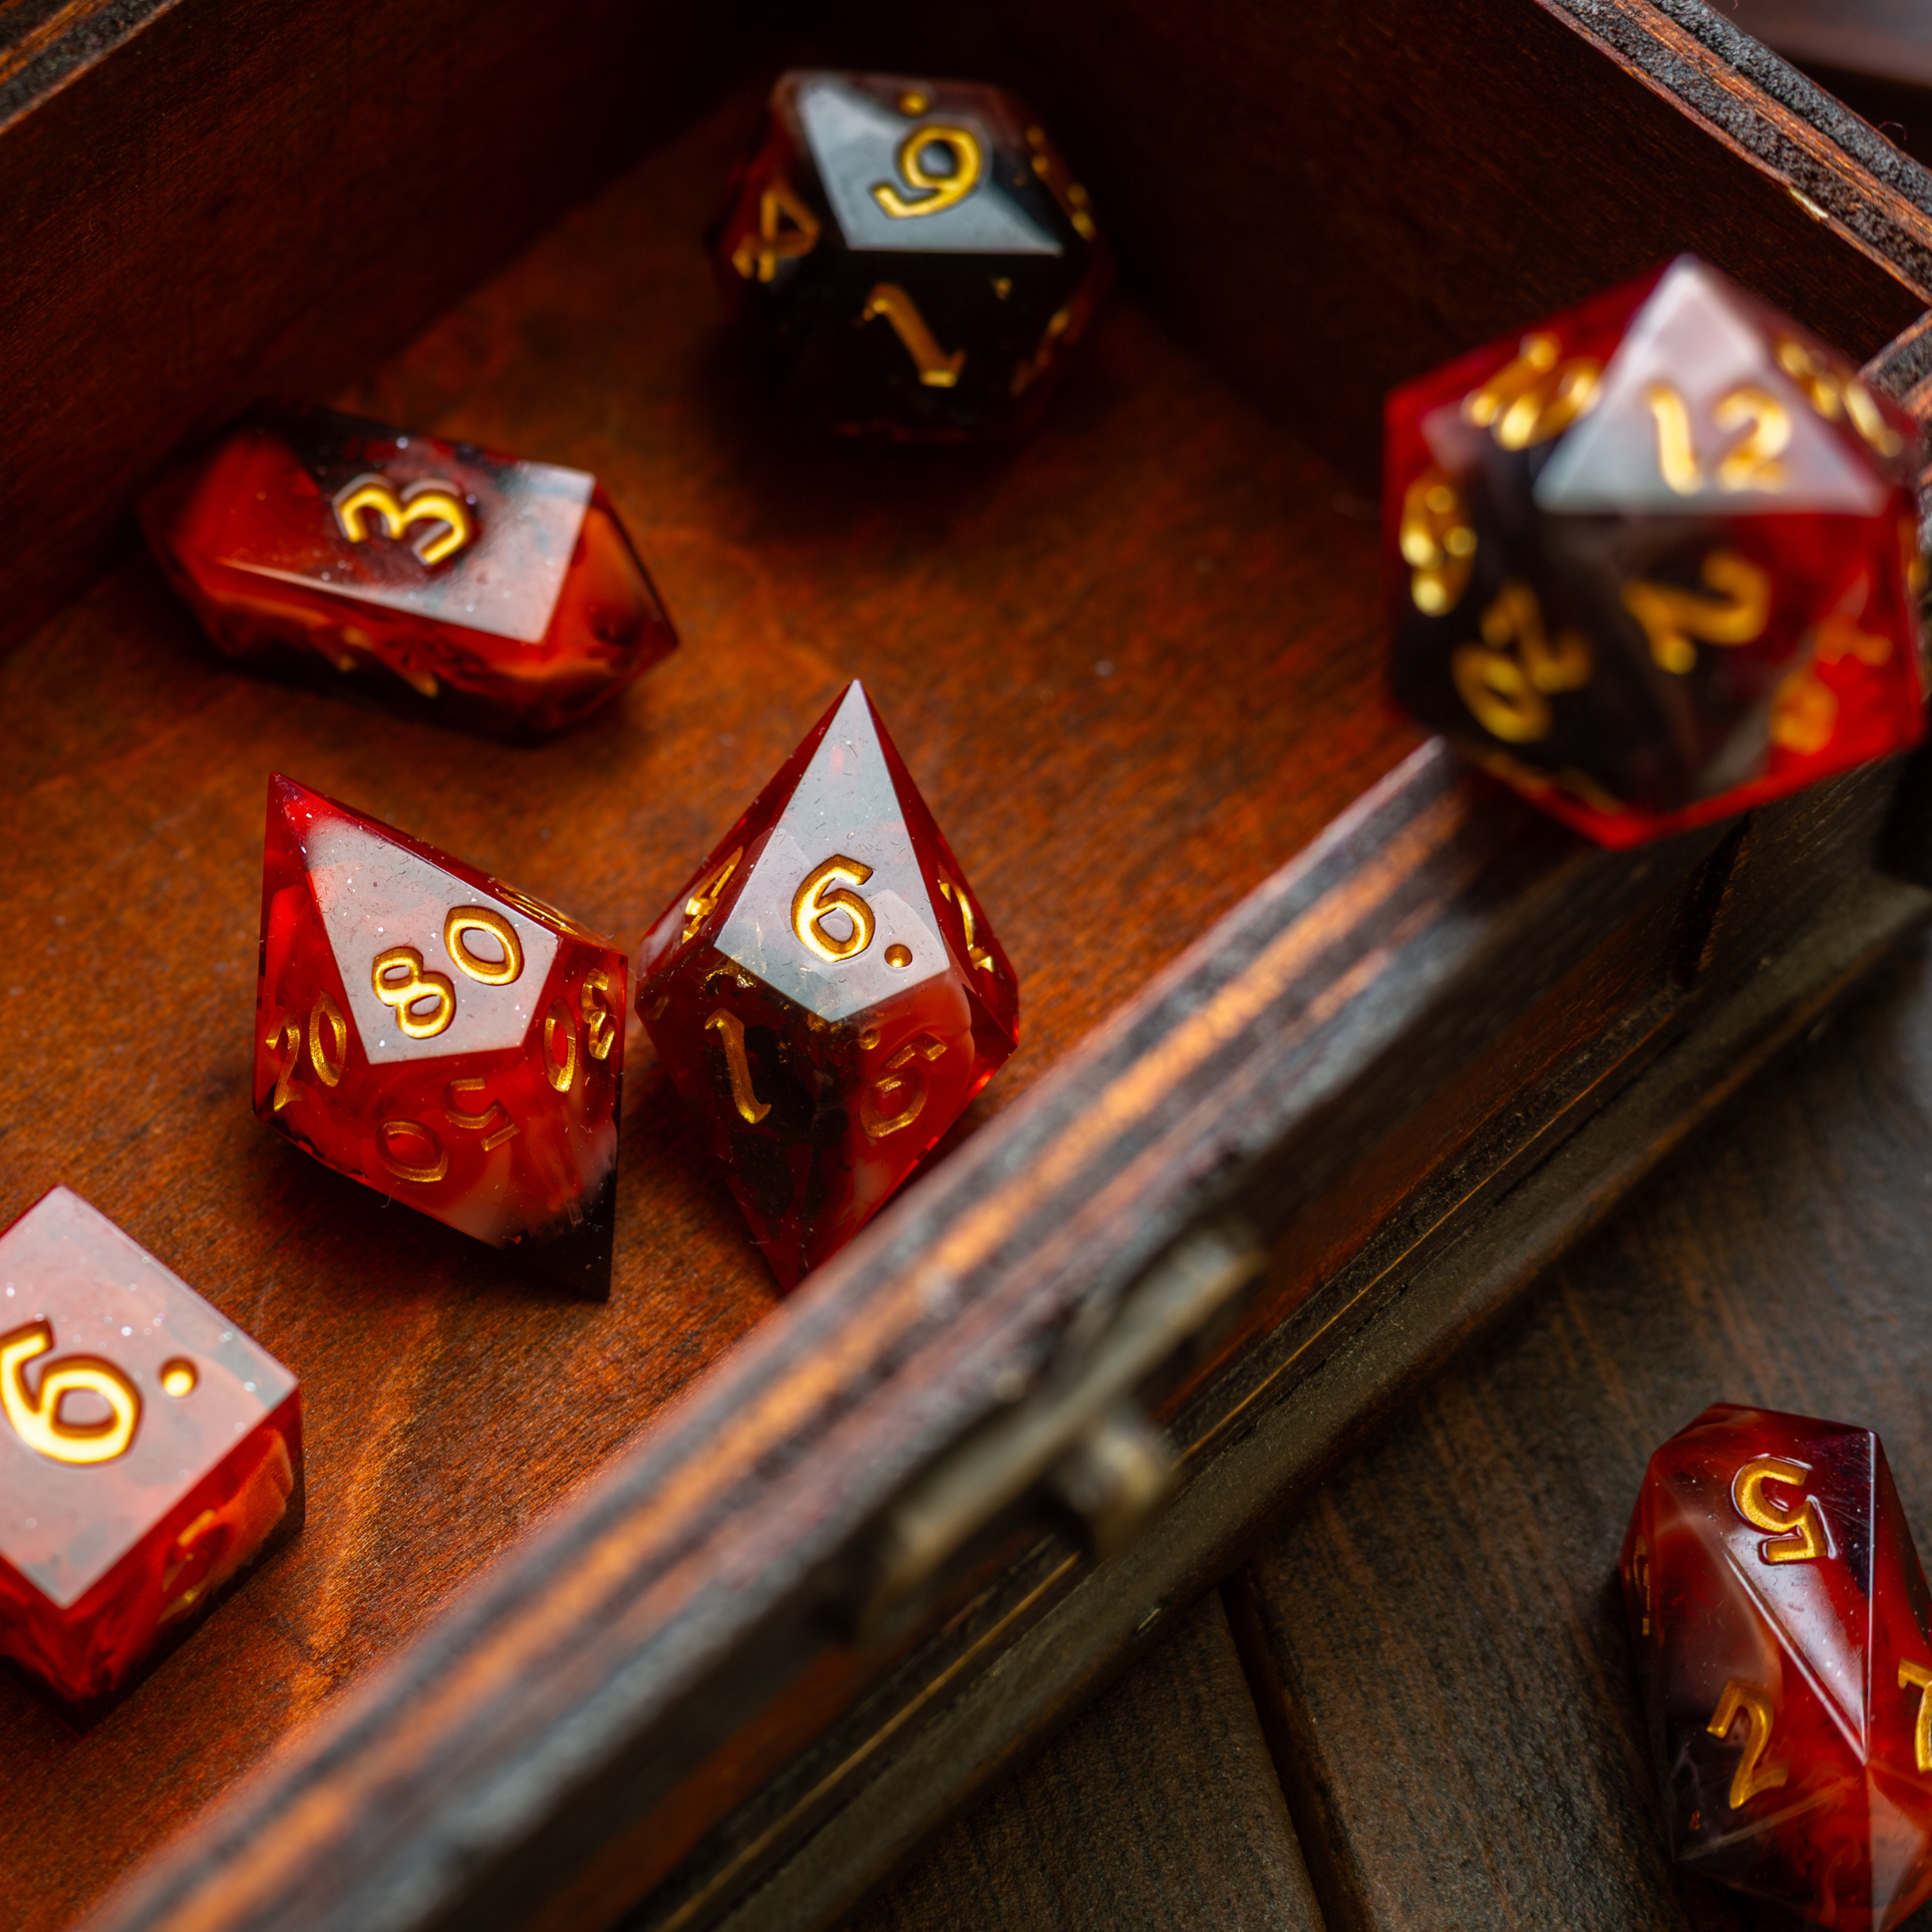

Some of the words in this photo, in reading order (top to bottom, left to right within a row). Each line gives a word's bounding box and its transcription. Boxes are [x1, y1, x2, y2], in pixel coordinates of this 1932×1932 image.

[1649, 383, 1792, 495] 12
[334, 476, 470, 565] 3
[372, 905, 524, 1039] 80
[1733, 1455, 1835, 1565] 5
[1707, 1680, 1790, 1809] 2
